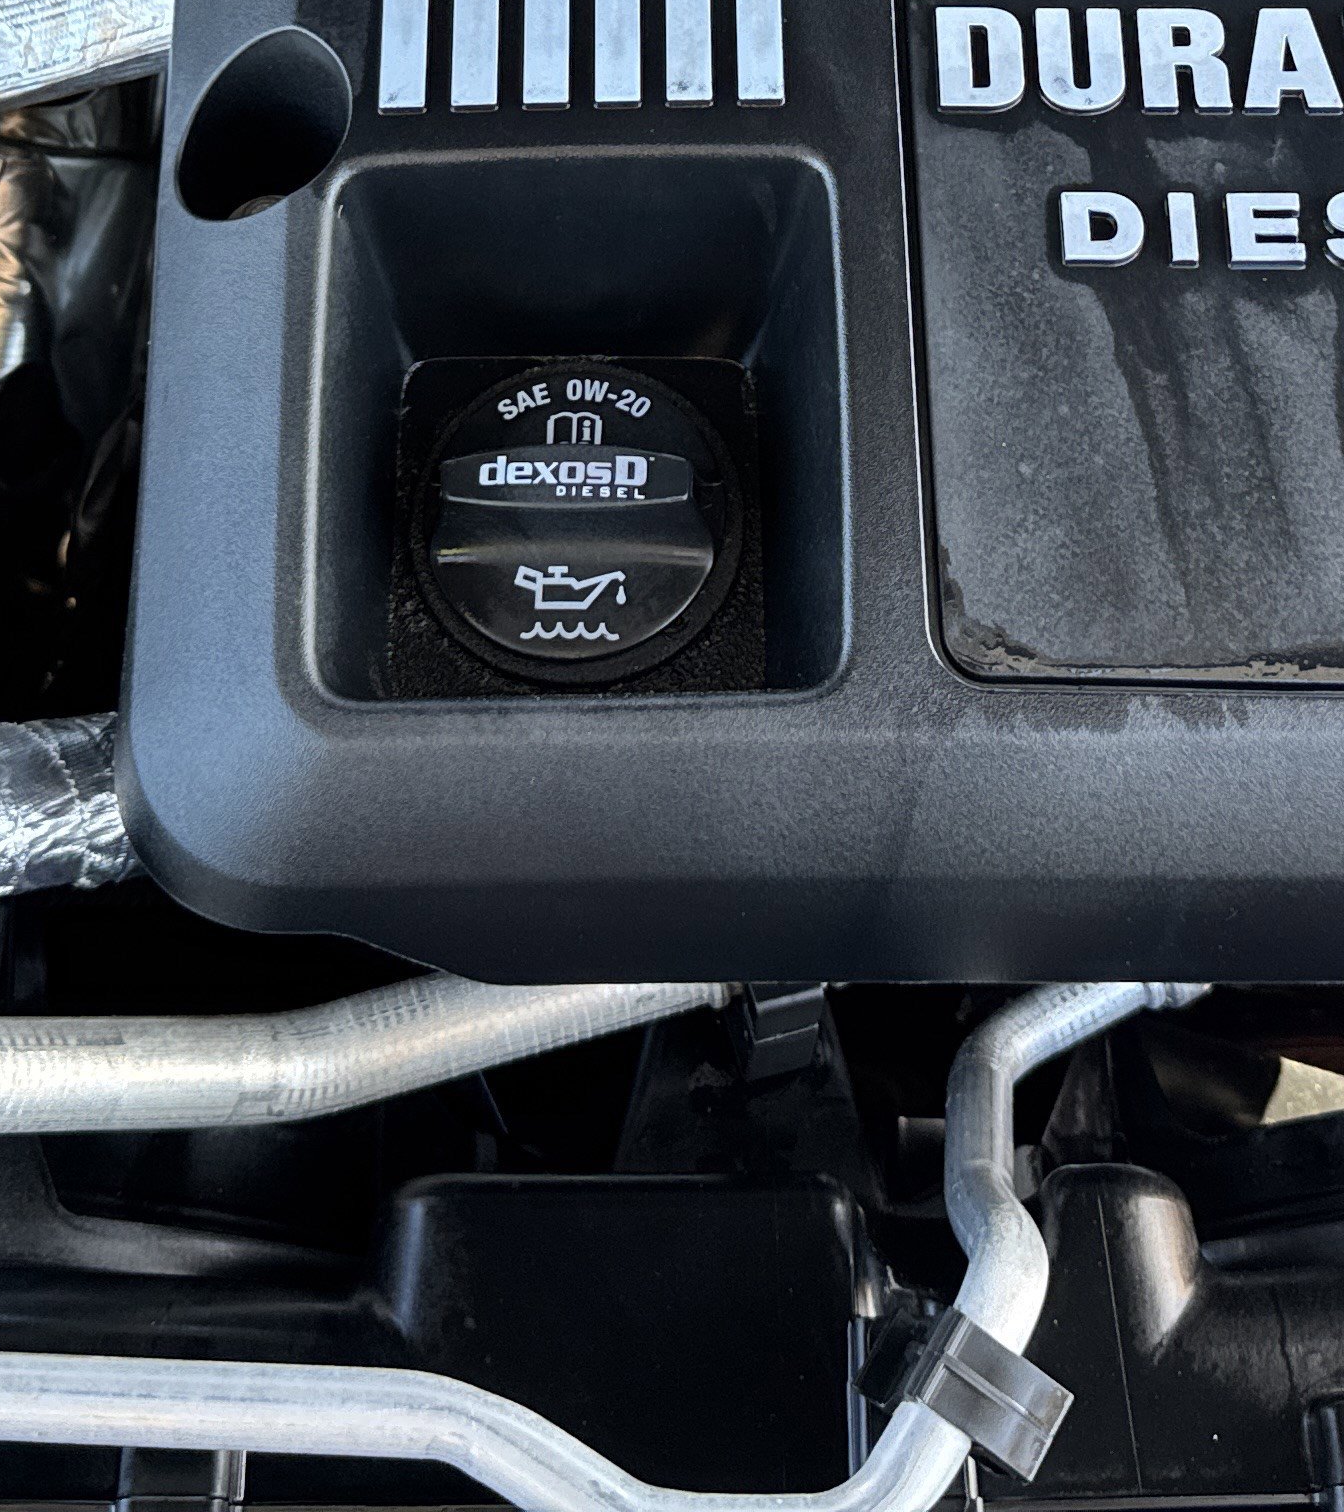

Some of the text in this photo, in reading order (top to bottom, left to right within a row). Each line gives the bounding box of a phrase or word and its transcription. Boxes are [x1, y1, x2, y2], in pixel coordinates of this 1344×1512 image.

[497, 378, 652, 420] SAE 0W-20
[555, 485, 646, 500] DIESEL
